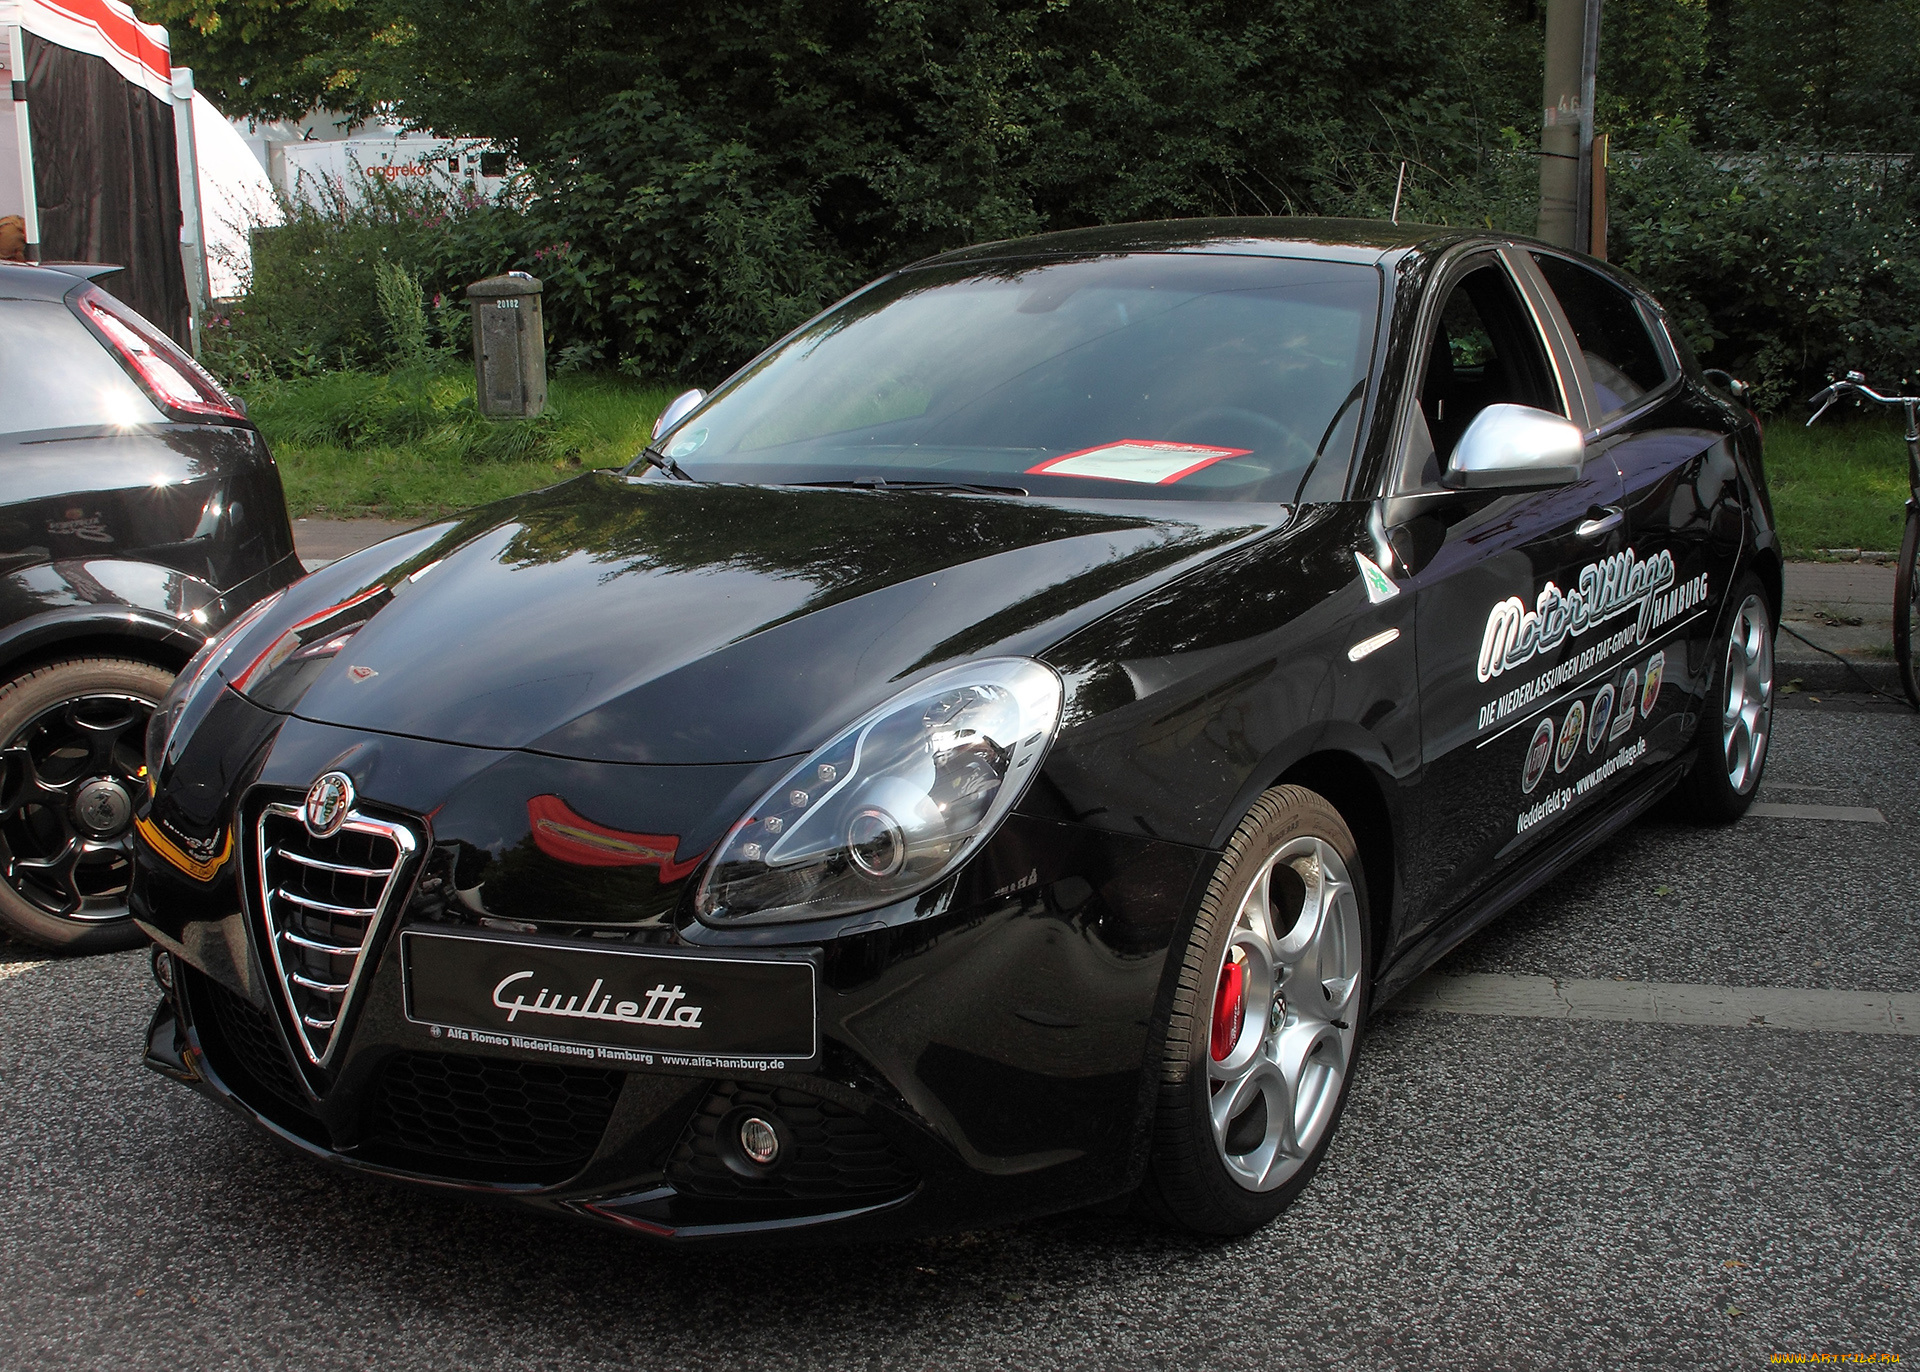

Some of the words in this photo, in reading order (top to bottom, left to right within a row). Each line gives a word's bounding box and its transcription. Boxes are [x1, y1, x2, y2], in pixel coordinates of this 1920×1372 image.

[496, 299, 519, 309] 20182
[1652, 572, 1708, 629] HAMBURG
[1478, 699, 1498, 731] DIE
[1497, 655, 1580, 716] NIEDERLASSUNGEN
[1578, 647, 1596, 673] DER
[1595, 623, 1637, 664] FIAT-GROUP
[1517, 788, 1561, 834] Nedderfeld
[1560, 787, 1572, 811] 30
[1576, 736, 1647, 796] www.motorvillage.de
[492, 970, 703, 1028] Giulietta
[447, 1028, 469, 1041] Alfa
[471, 1031, 510, 1047] Romeo
[511, 1037, 595, 1059] Niederlassung
[597, 1048, 654, 1065] Hamburg
[661, 1055, 785, 1072] www.alfa-hamburg.de
